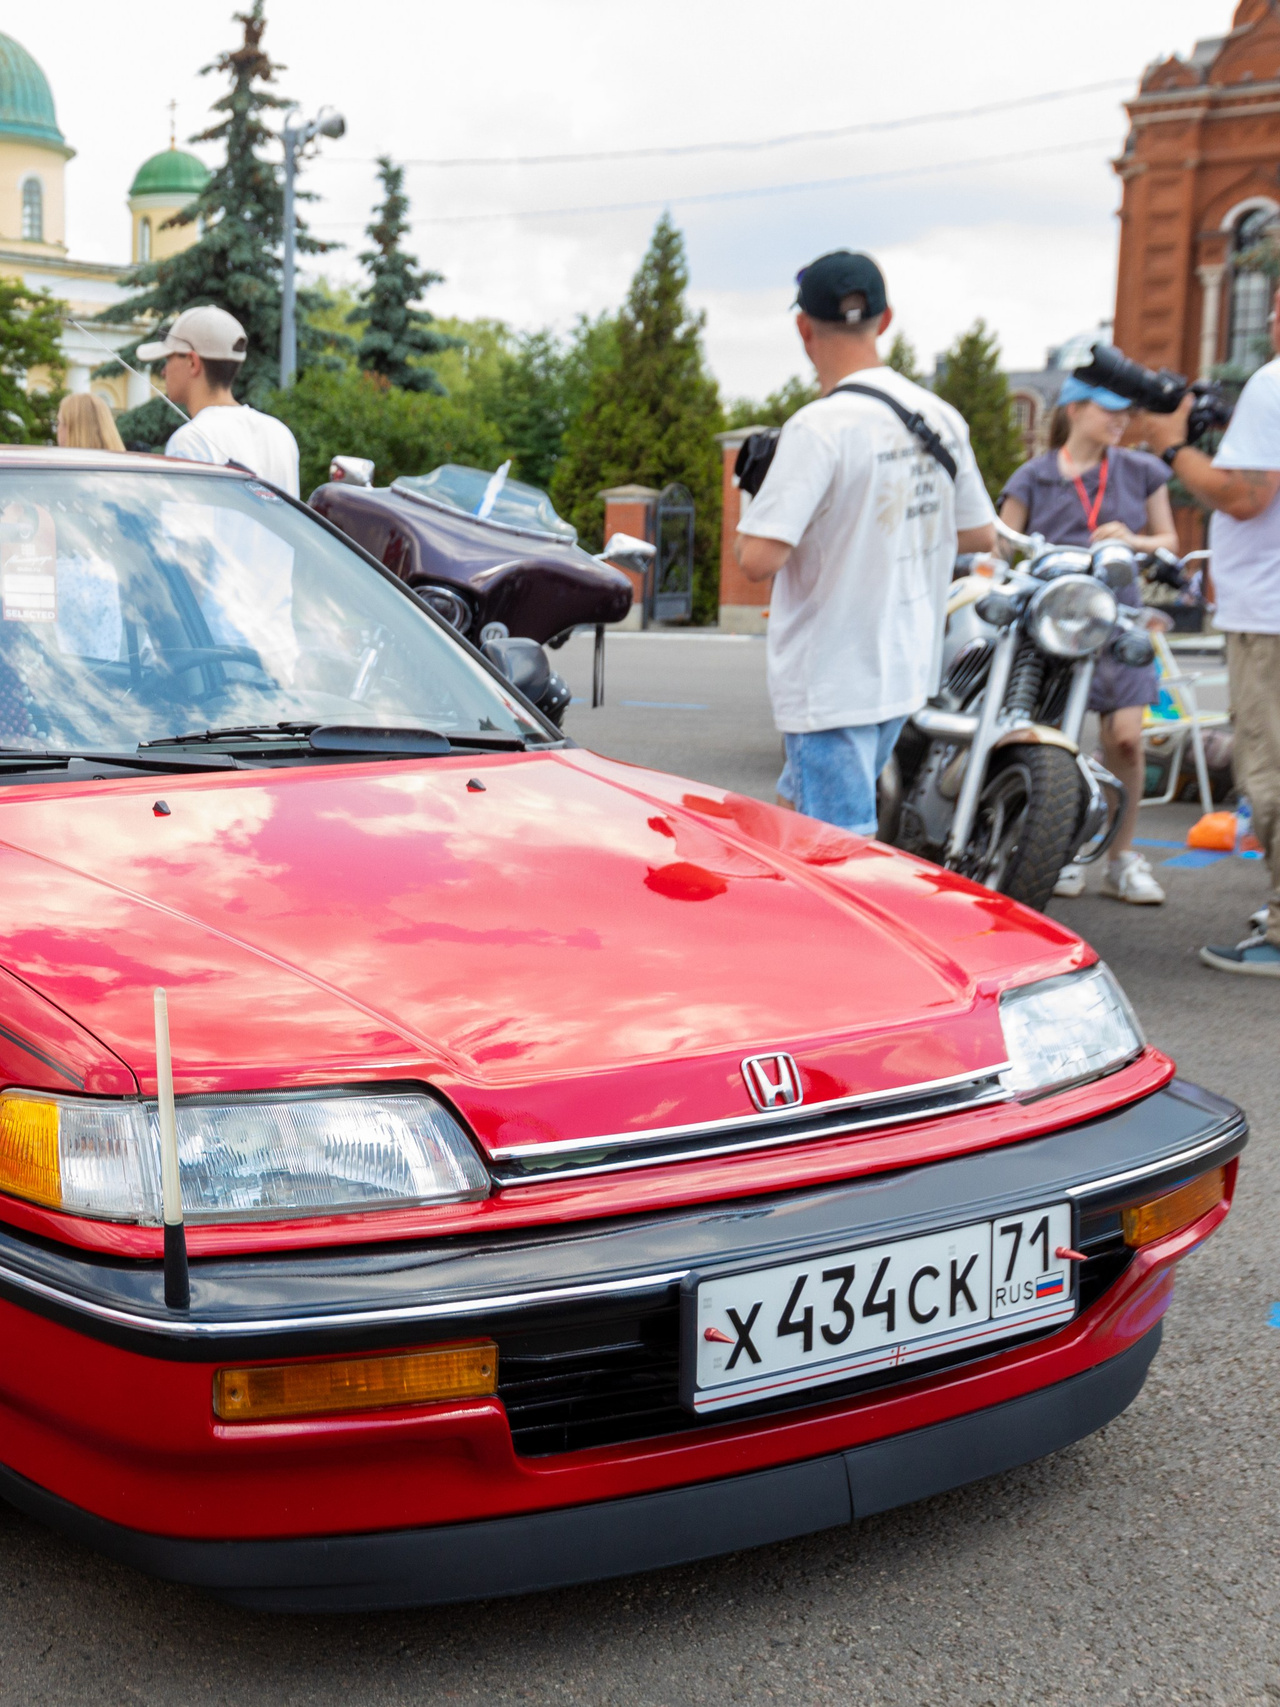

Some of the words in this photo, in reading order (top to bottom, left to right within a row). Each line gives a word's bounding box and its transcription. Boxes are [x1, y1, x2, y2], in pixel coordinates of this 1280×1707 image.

[5, 608, 56, 620] SELECTED
[999, 1214, 1050, 1283] 71
[995, 1280, 1034, 1309] RUS
